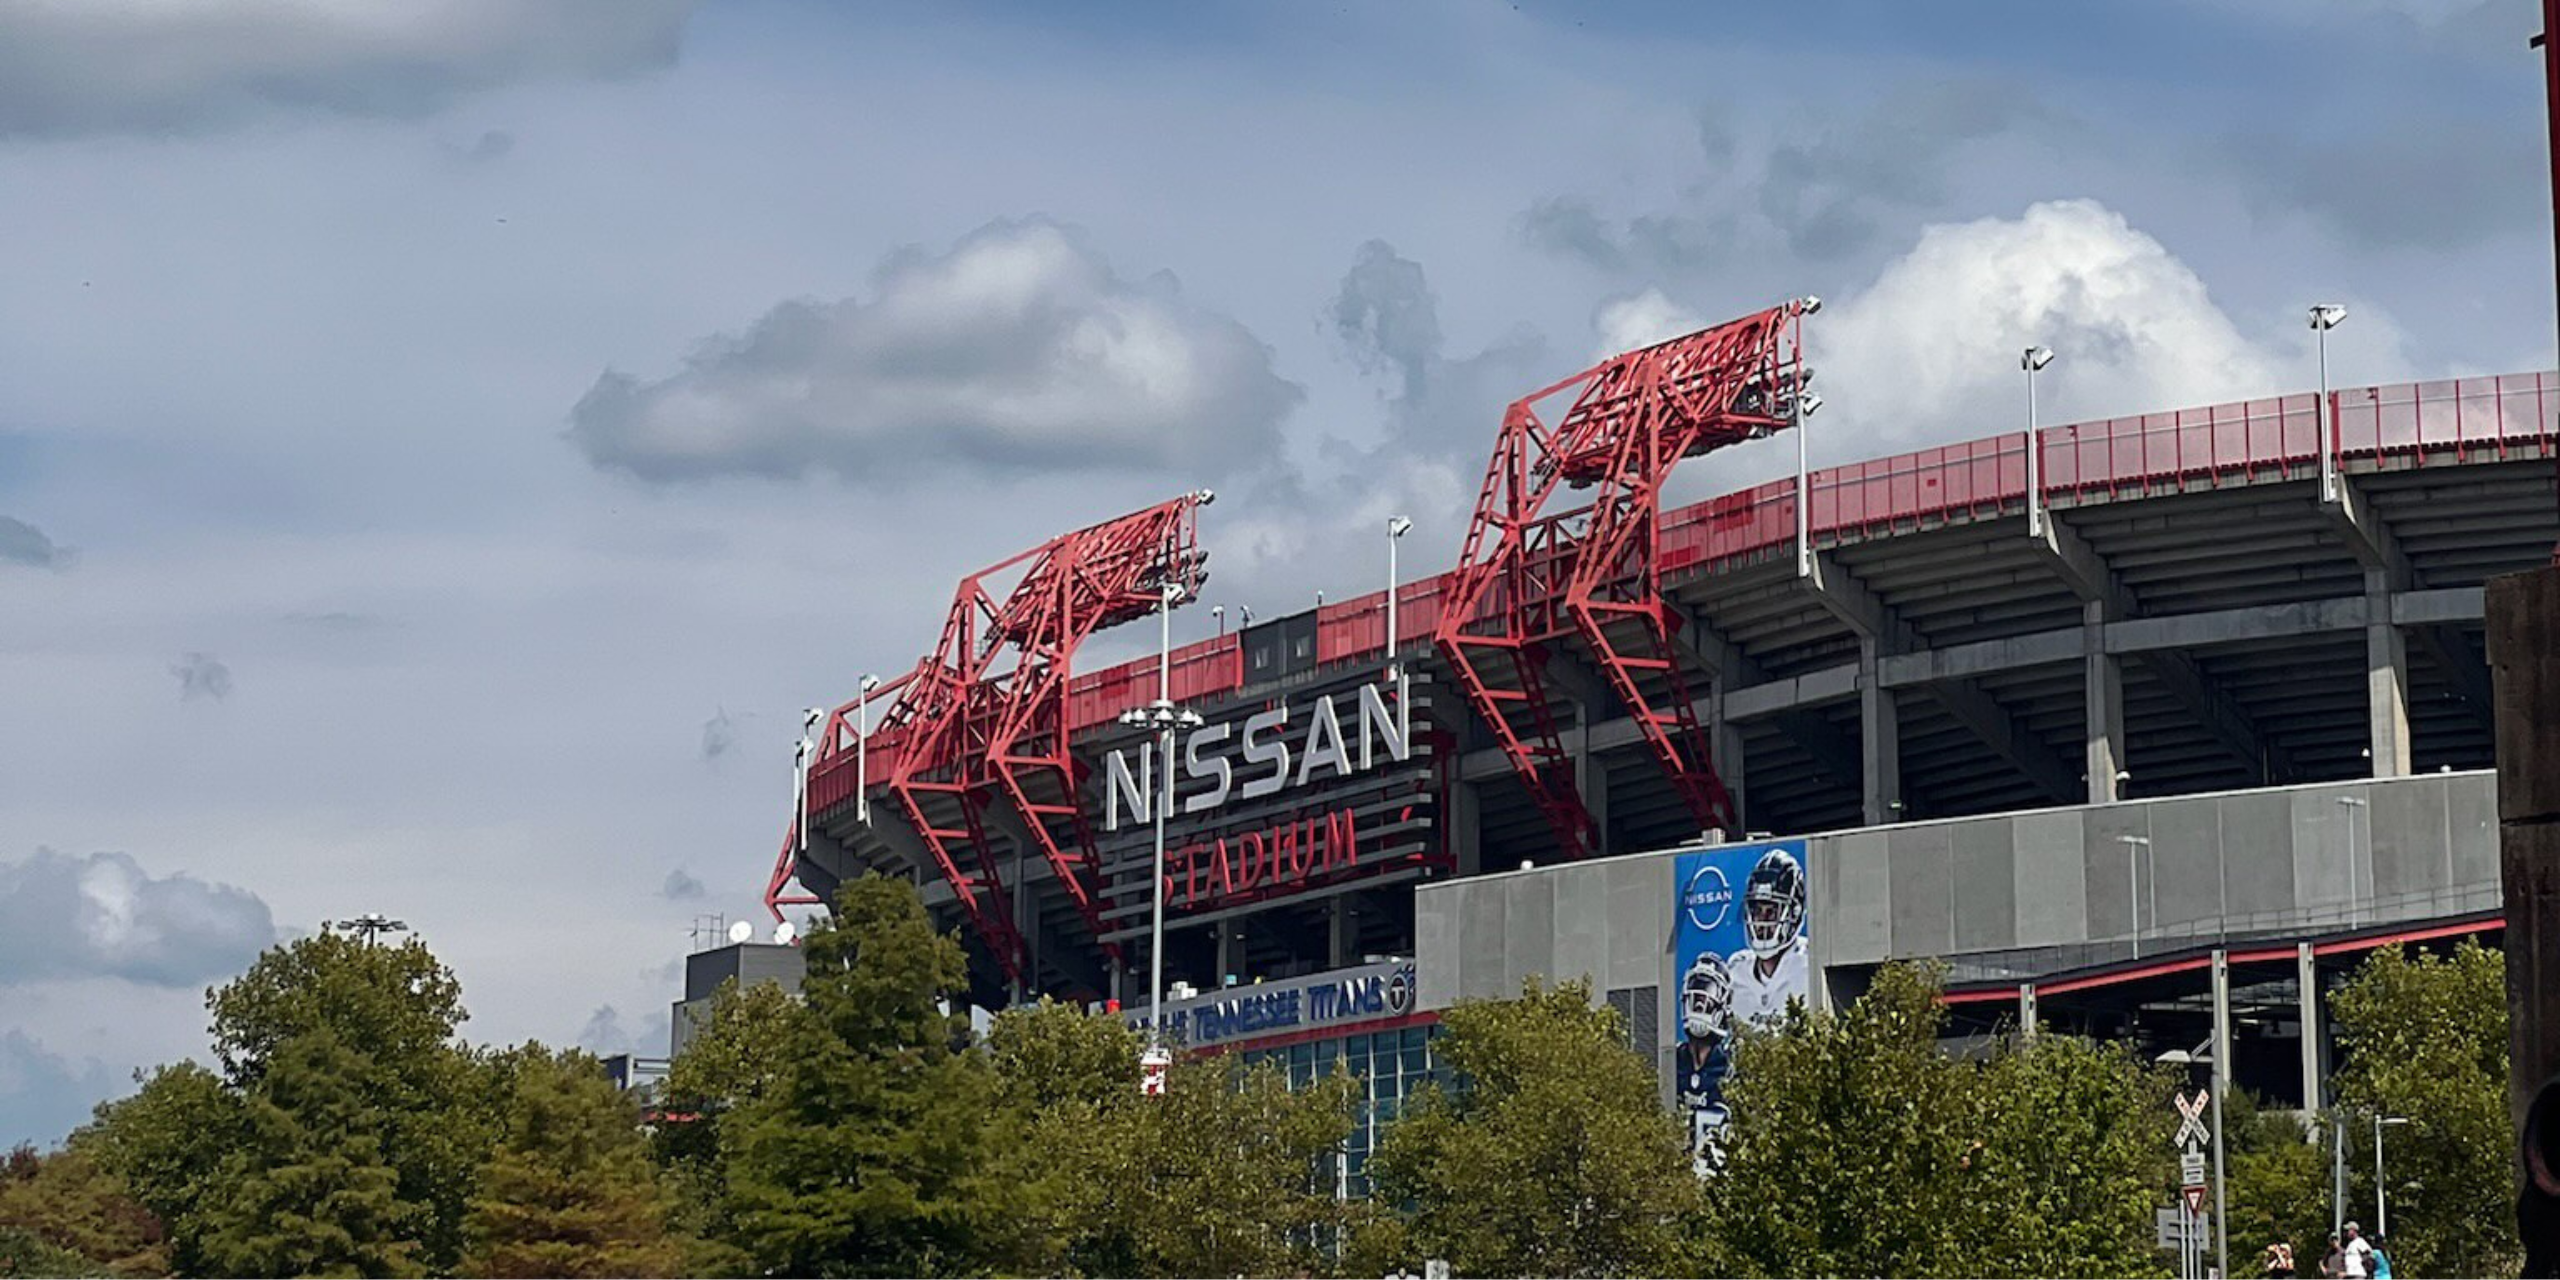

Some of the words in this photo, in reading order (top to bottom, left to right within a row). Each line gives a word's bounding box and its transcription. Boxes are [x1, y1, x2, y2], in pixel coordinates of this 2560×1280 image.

[1106, 673, 1409, 831] NISSAN
[1154, 808, 1357, 906] STADIUM
[1684, 889, 1733, 905] NISSAN
[1193, 987, 1302, 1041] TENNESSEE
[1307, 974, 1385, 1022] TITANS
